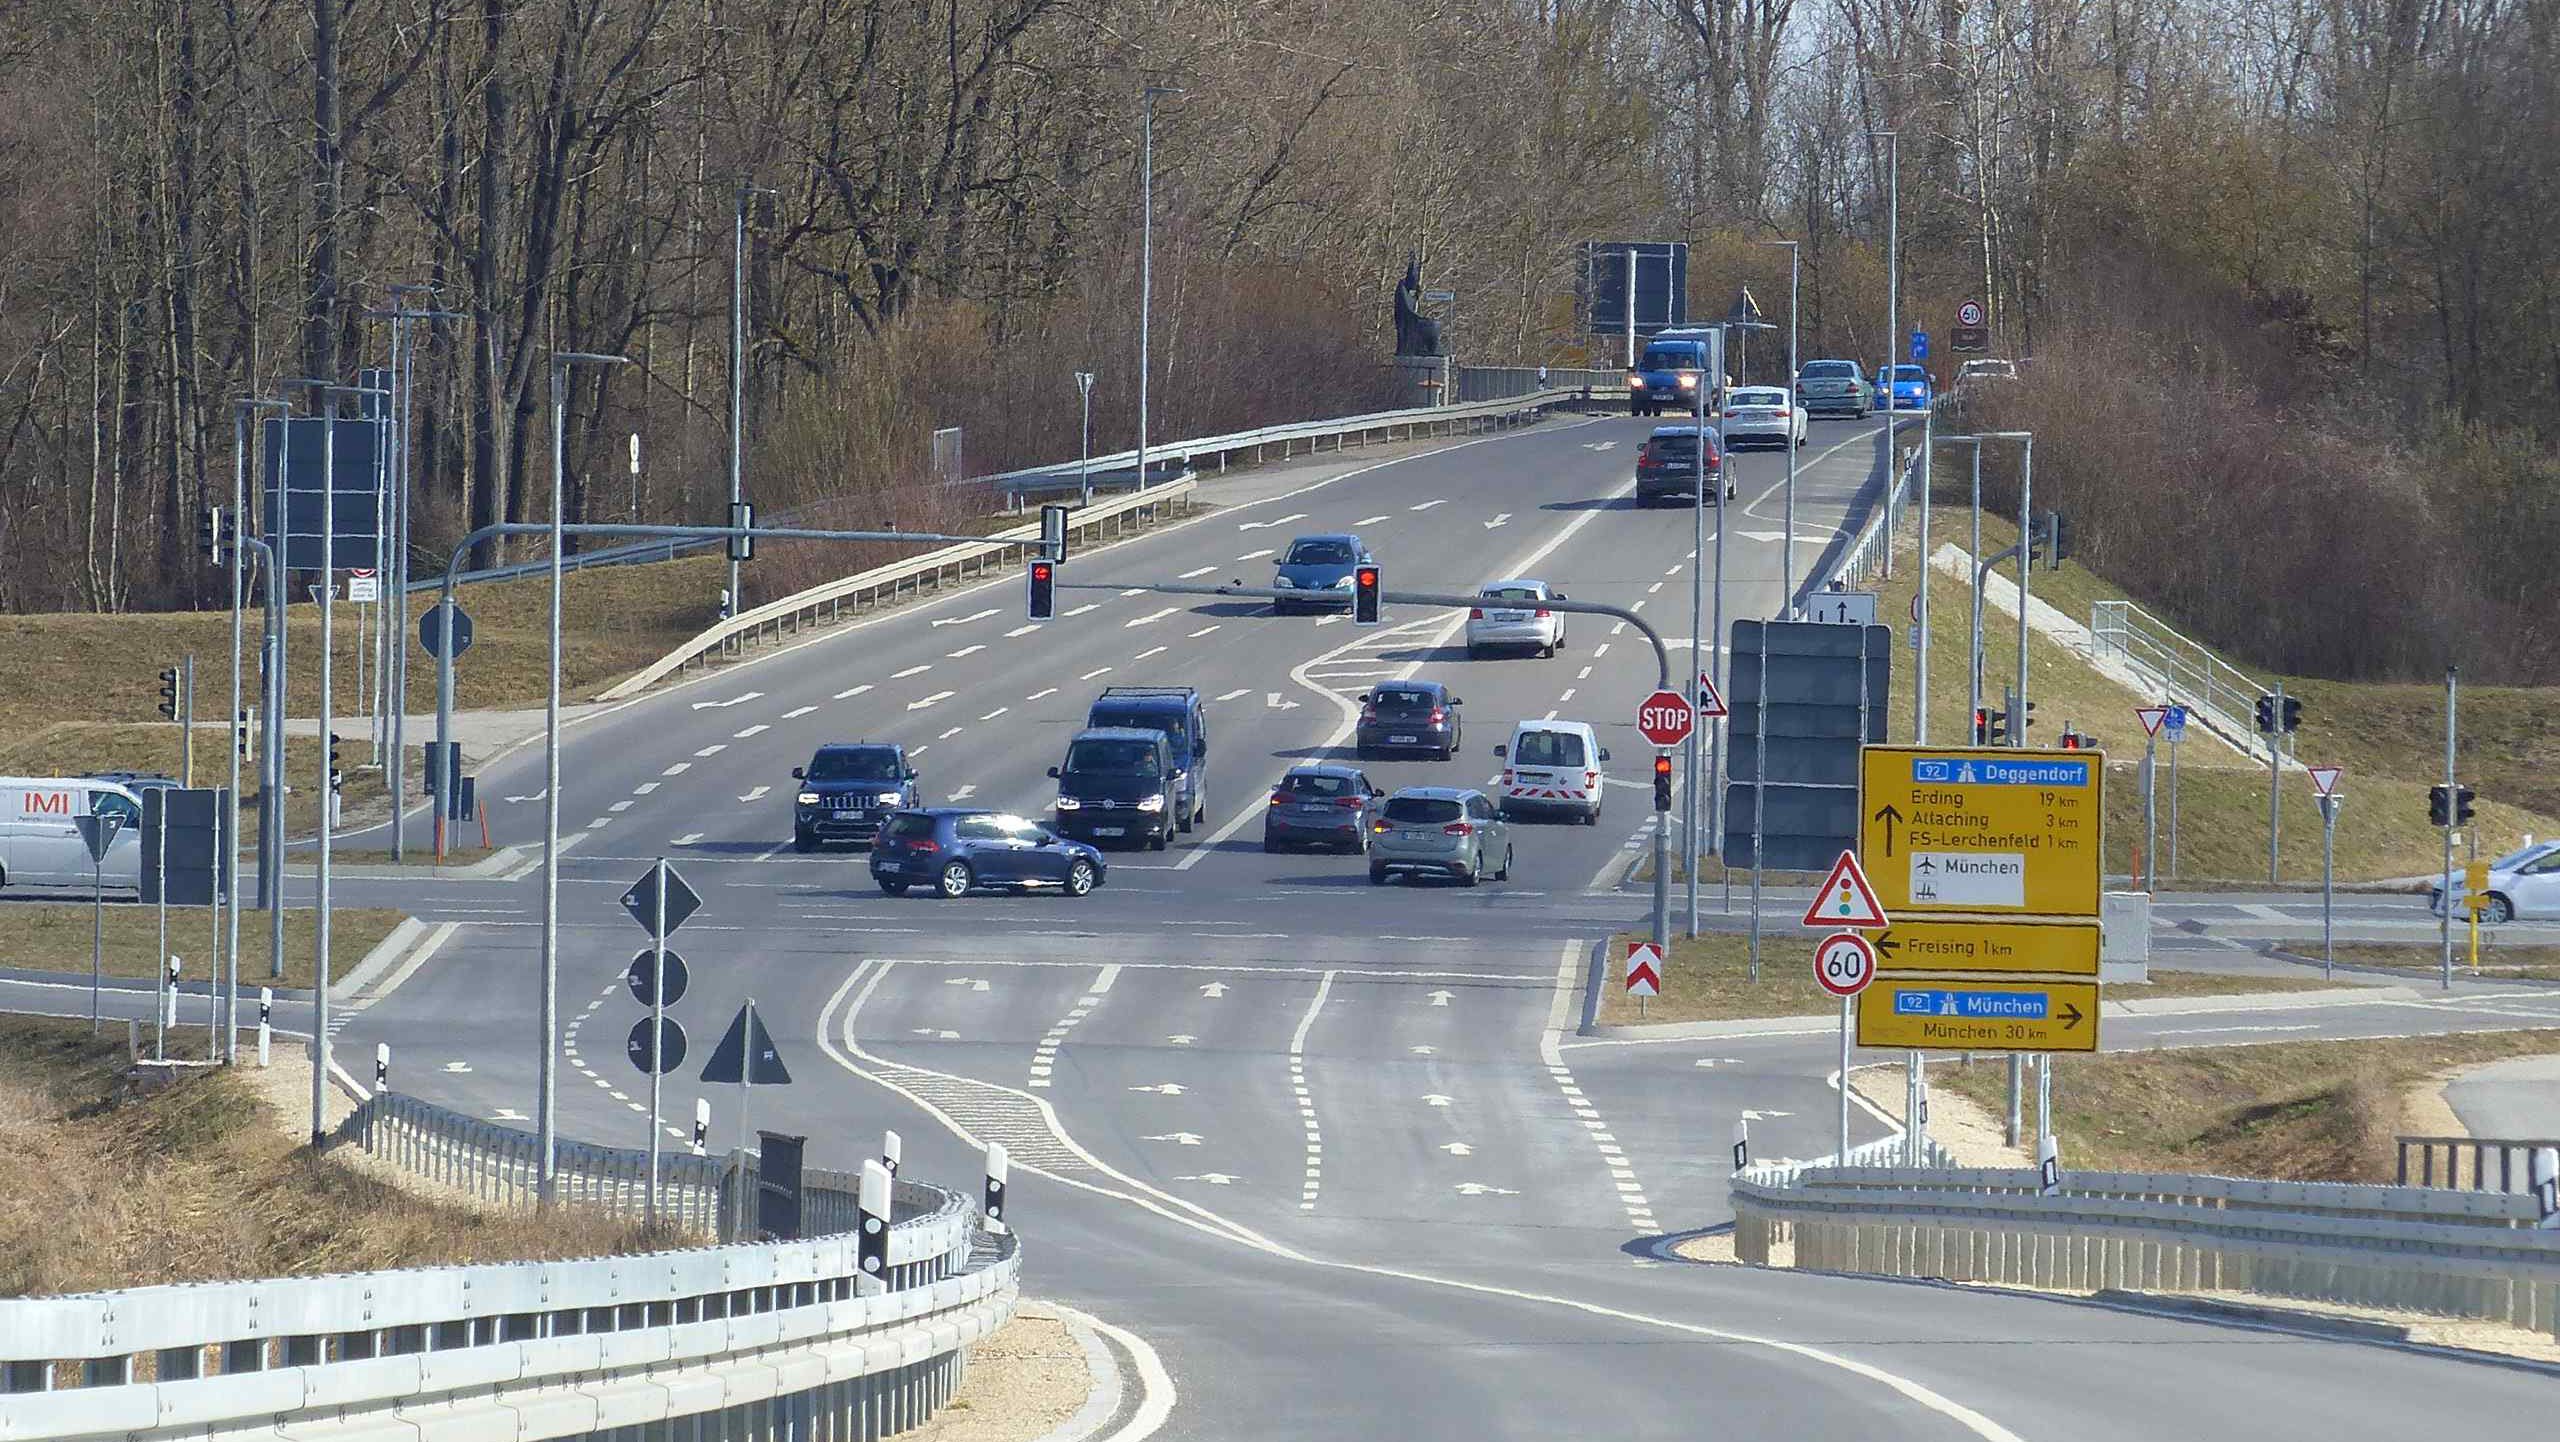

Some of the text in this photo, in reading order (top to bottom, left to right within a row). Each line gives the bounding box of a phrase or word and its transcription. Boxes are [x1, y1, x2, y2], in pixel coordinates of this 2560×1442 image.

[1963, 307, 1978, 320] 60
[1642, 707, 1689, 730] STOP
[1925, 765, 2083, 784] 92 Deggendorf
[25, 792, 68, 815] IMI
[1911, 790, 2079, 807] Erding 19 km
[1911, 811, 2079, 829] Attaching 3 km
[1909, 832, 2079, 849] FS-Lerchenfeld 1 km
[1945, 859, 2019, 874] München
[1908, 938, 1975, 957] Freising
[1828, 951, 1860, 978] 60
[1907, 997, 2043, 1014] 92 München
[1924, 1023, 2047, 1040] München 30 km
